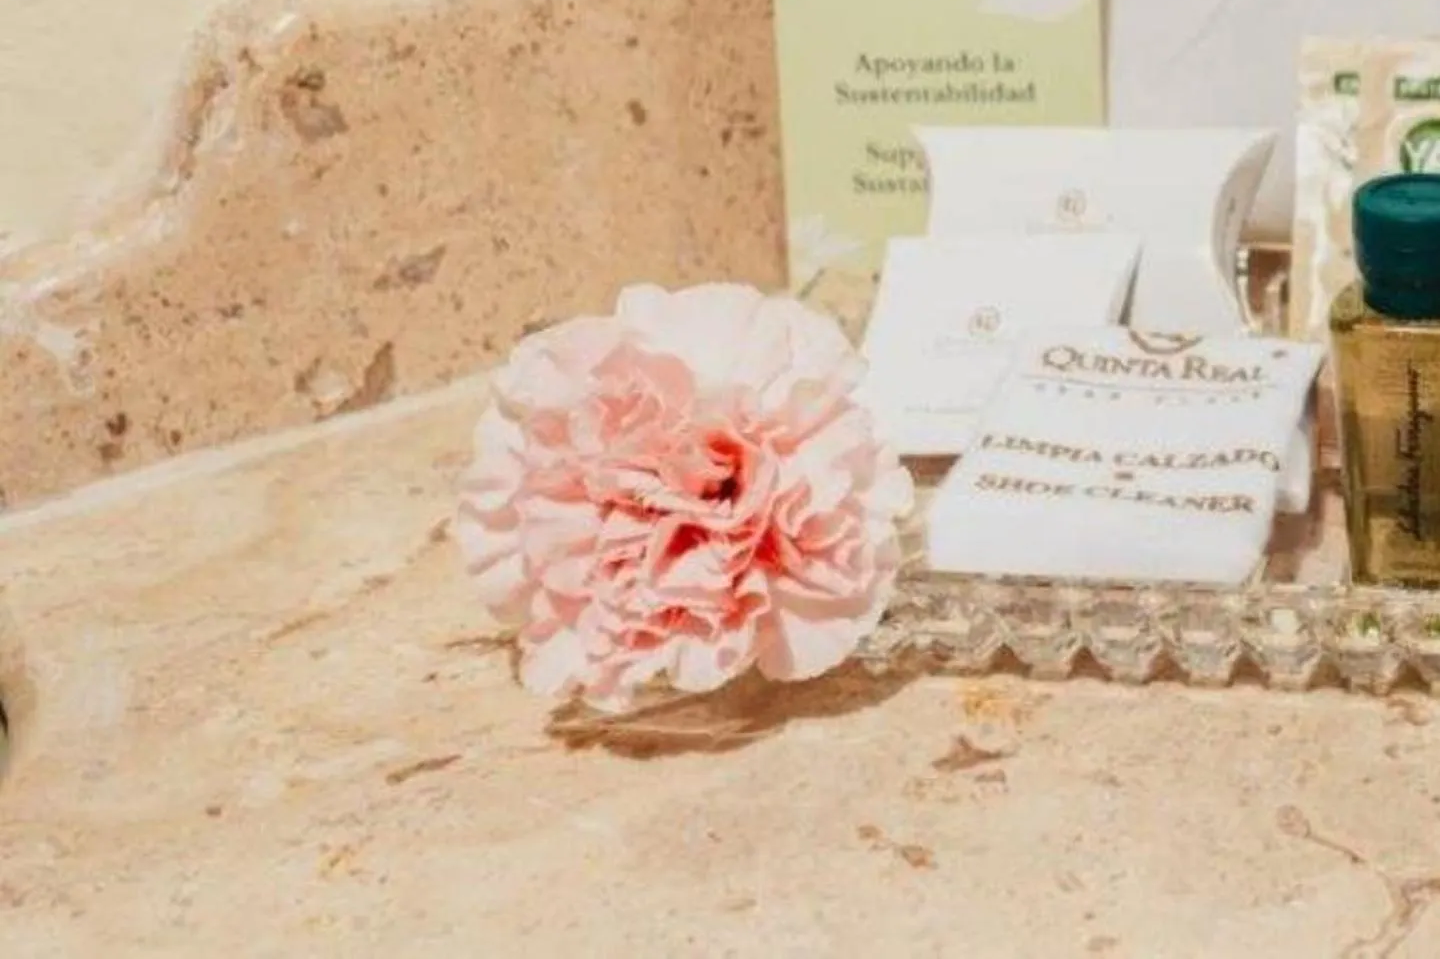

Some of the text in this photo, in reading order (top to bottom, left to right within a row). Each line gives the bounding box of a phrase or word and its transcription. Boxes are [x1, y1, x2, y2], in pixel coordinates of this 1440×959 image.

[855, 52, 1015, 79] Apoyando la
[834, 82, 1037, 105] Sustentabilidad
[1042, 345, 1173, 380] QUINTA
[1182, 355, 1268, 383] REAL
[981, 432, 1281, 472] LIMPIA CALZADO
[974, 472, 1256, 514] SHOE CLEANER
